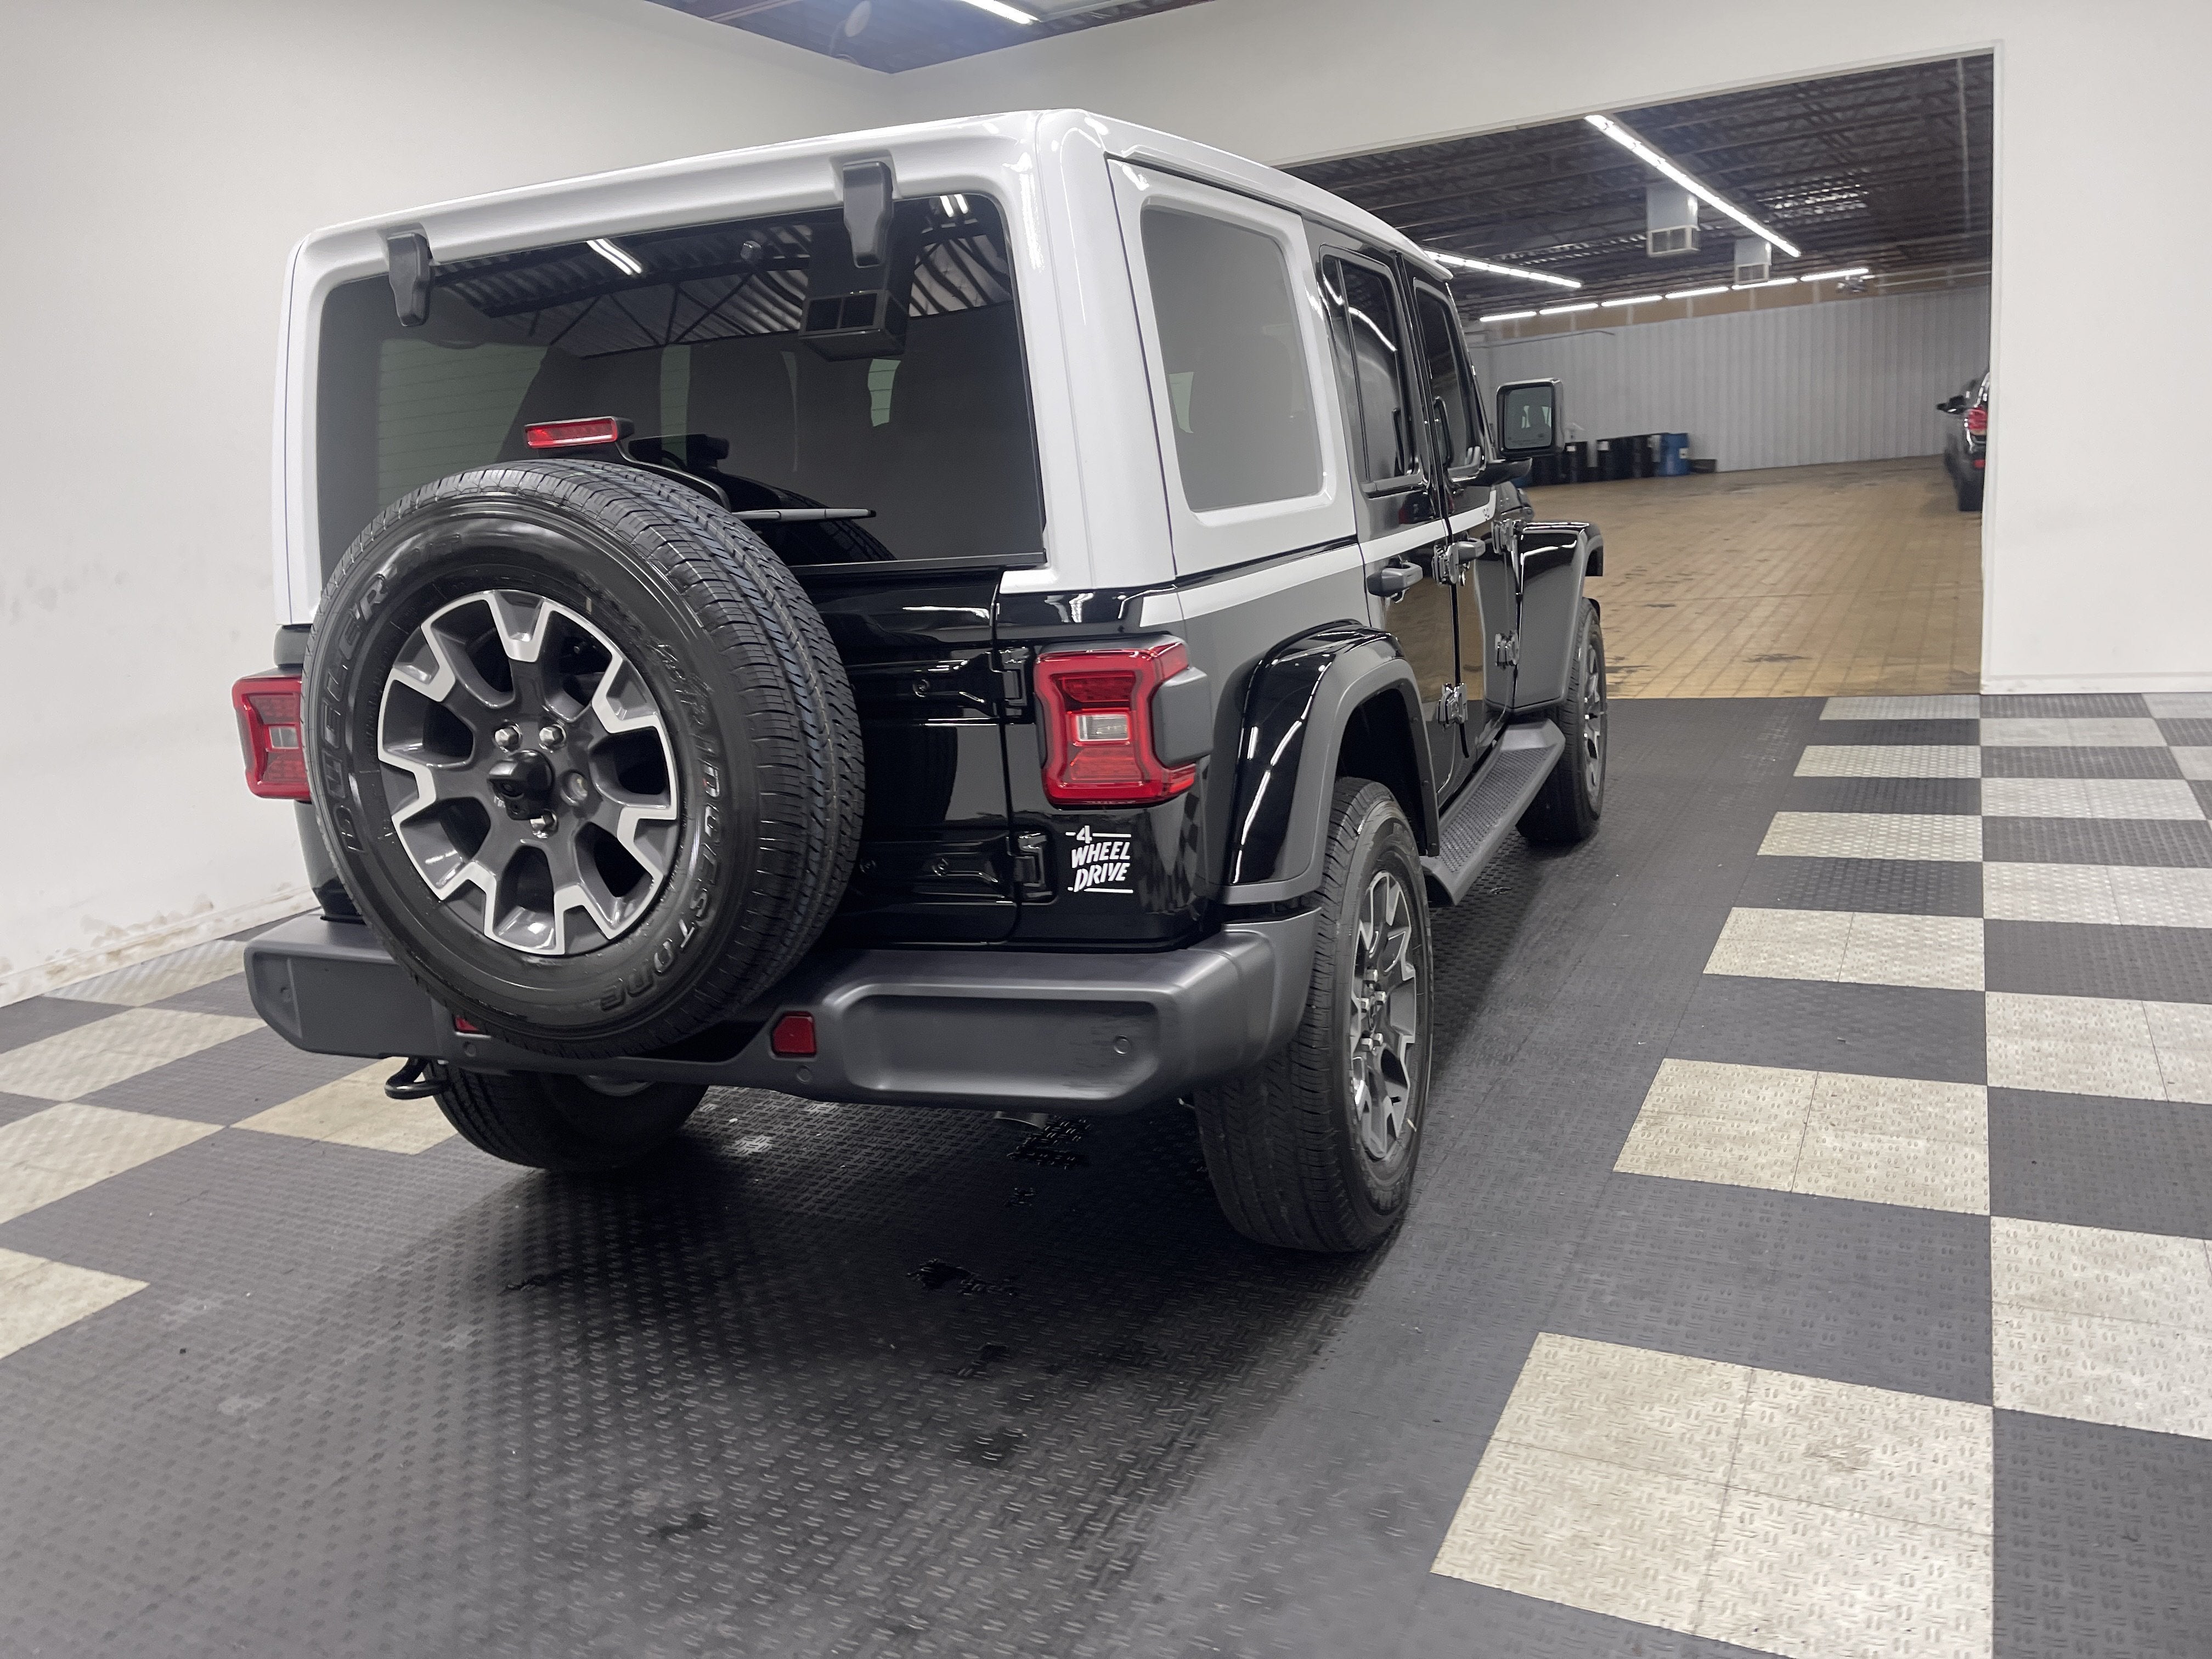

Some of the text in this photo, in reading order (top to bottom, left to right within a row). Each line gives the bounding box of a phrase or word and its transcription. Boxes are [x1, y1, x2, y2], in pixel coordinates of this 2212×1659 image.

[321, 573, 388, 853] DUELER
[1076, 825, 1092, 844] 4
[1071, 841, 1131, 868] WHEEL
[1073, 862, 1131, 893] DRIVE
